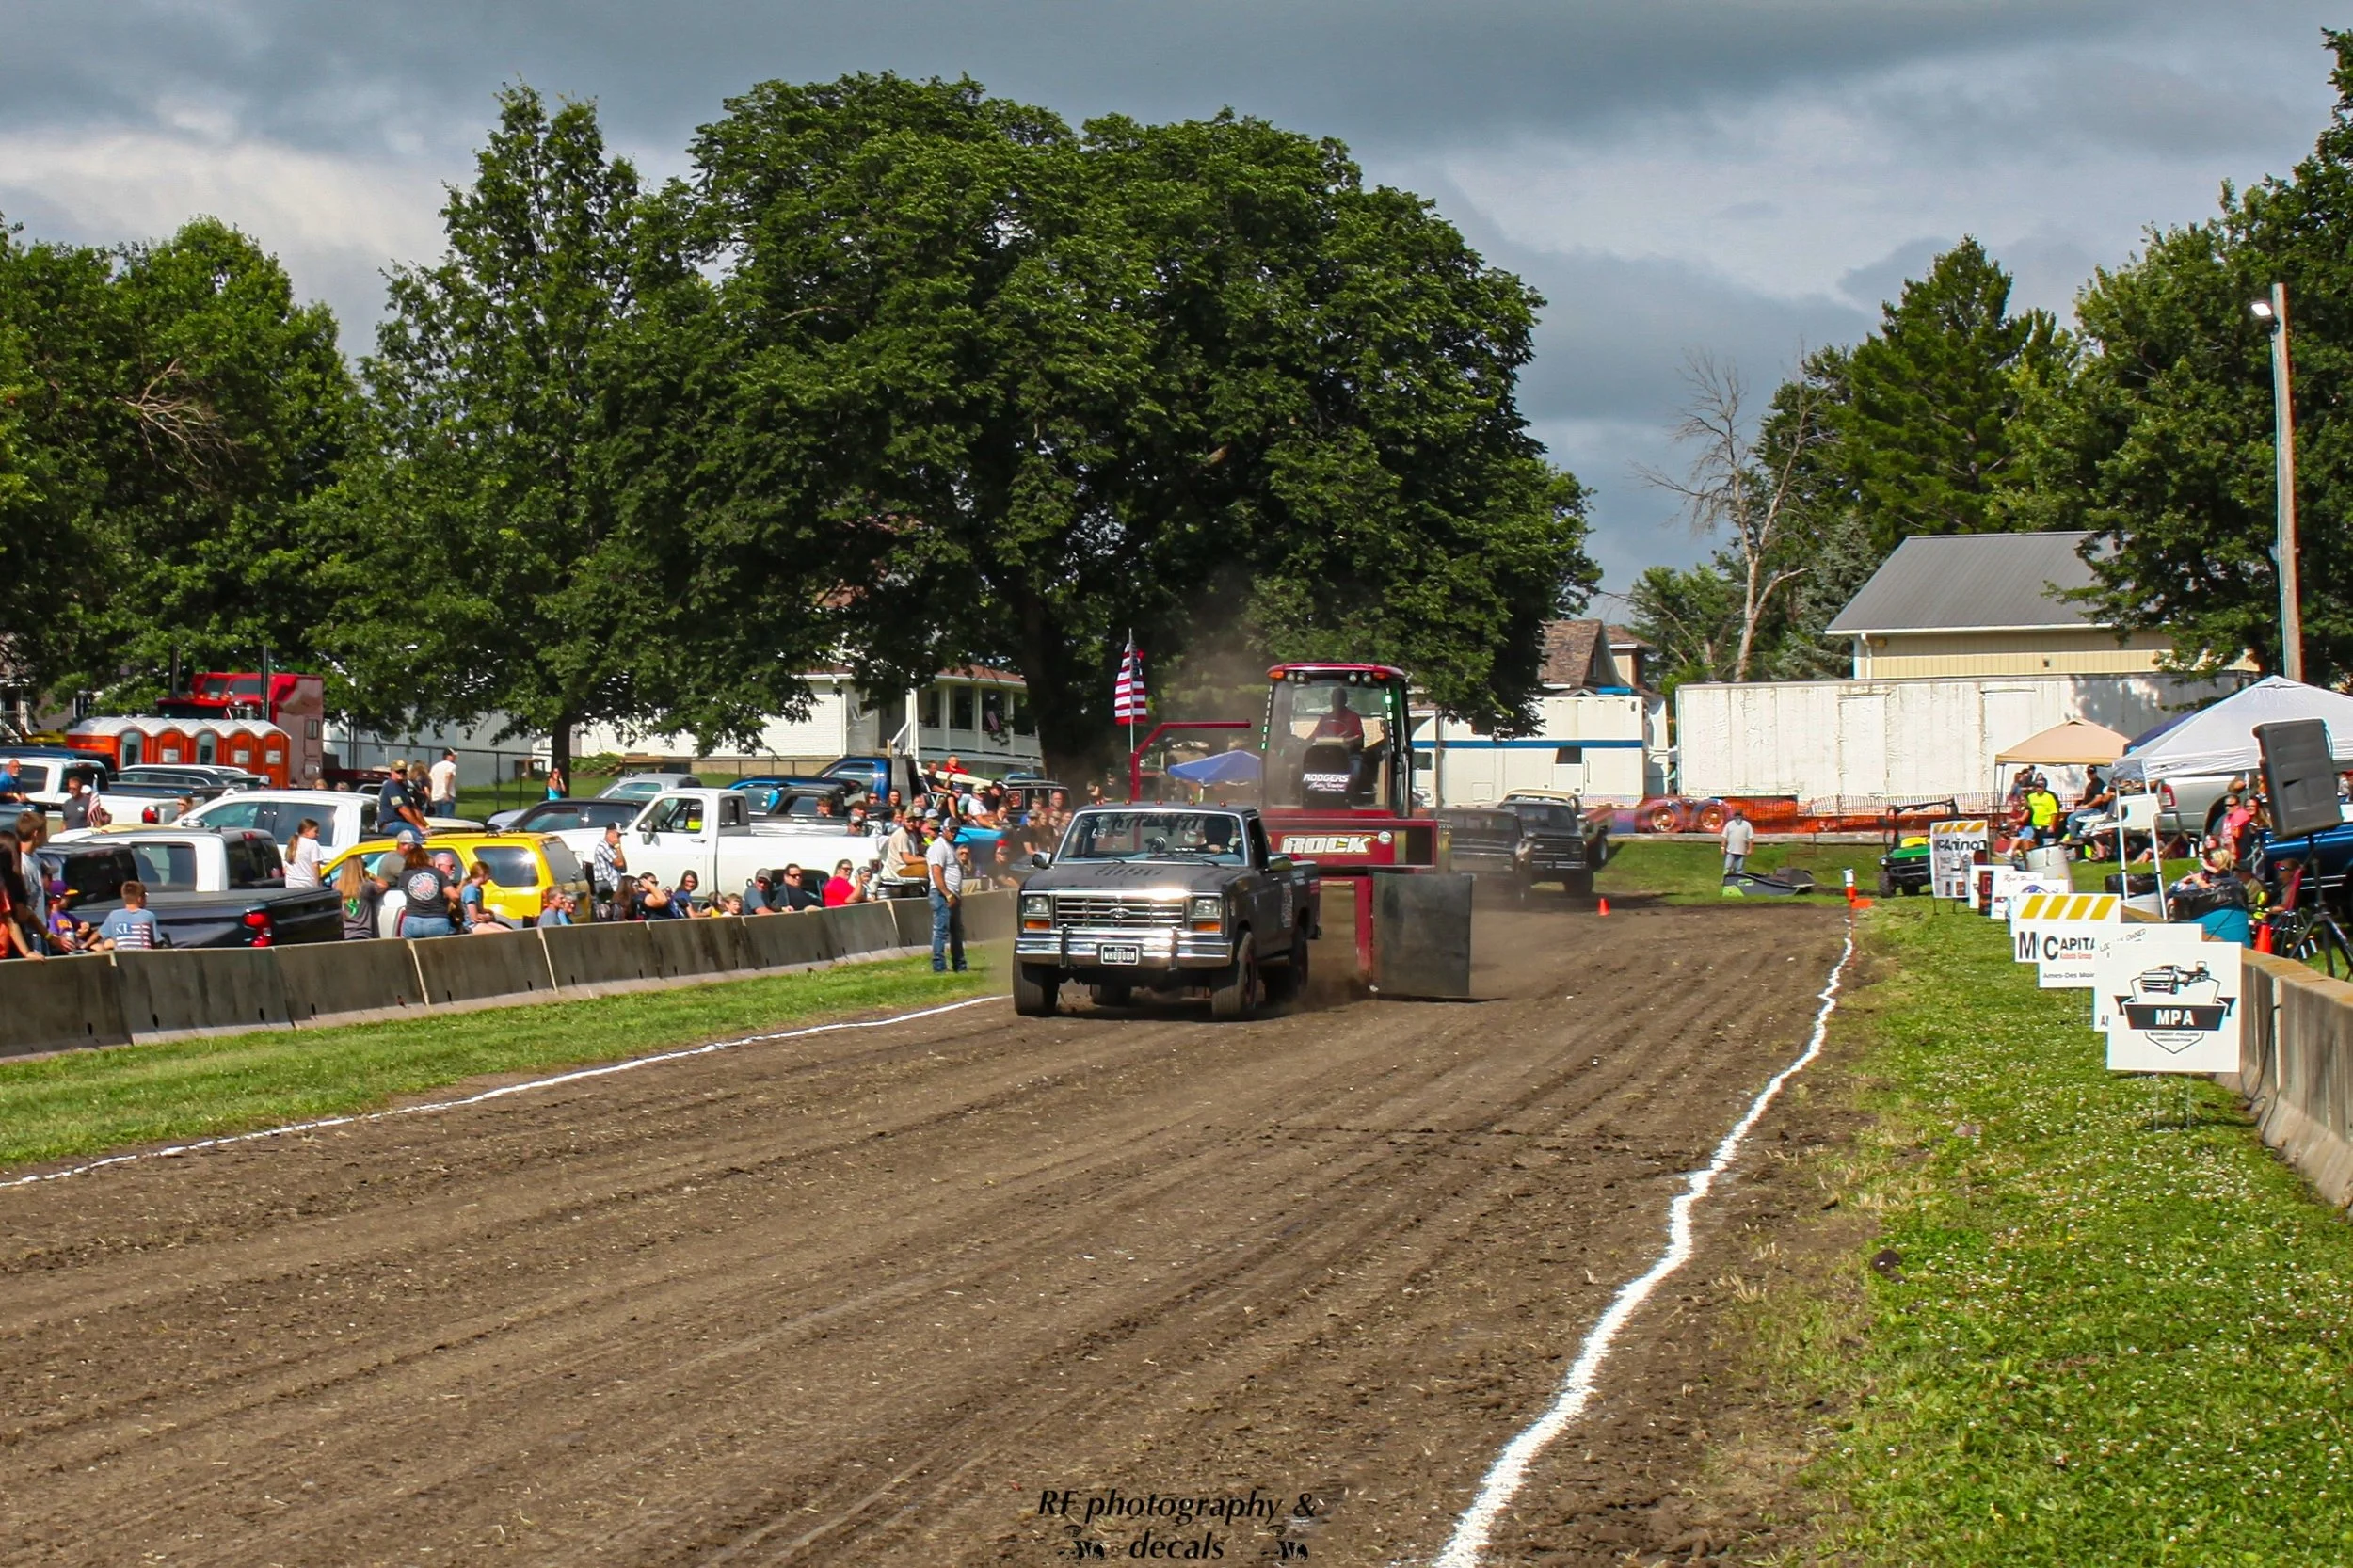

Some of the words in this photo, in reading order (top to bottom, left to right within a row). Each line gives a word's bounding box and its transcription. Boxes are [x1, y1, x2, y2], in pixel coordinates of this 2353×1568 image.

[1303, 774, 1350, 783] RODGERS
[1280, 836, 1373, 854] ROCK
[2019, 931, 2040, 960] M
[2155, 1009, 2195, 1027] MPA
